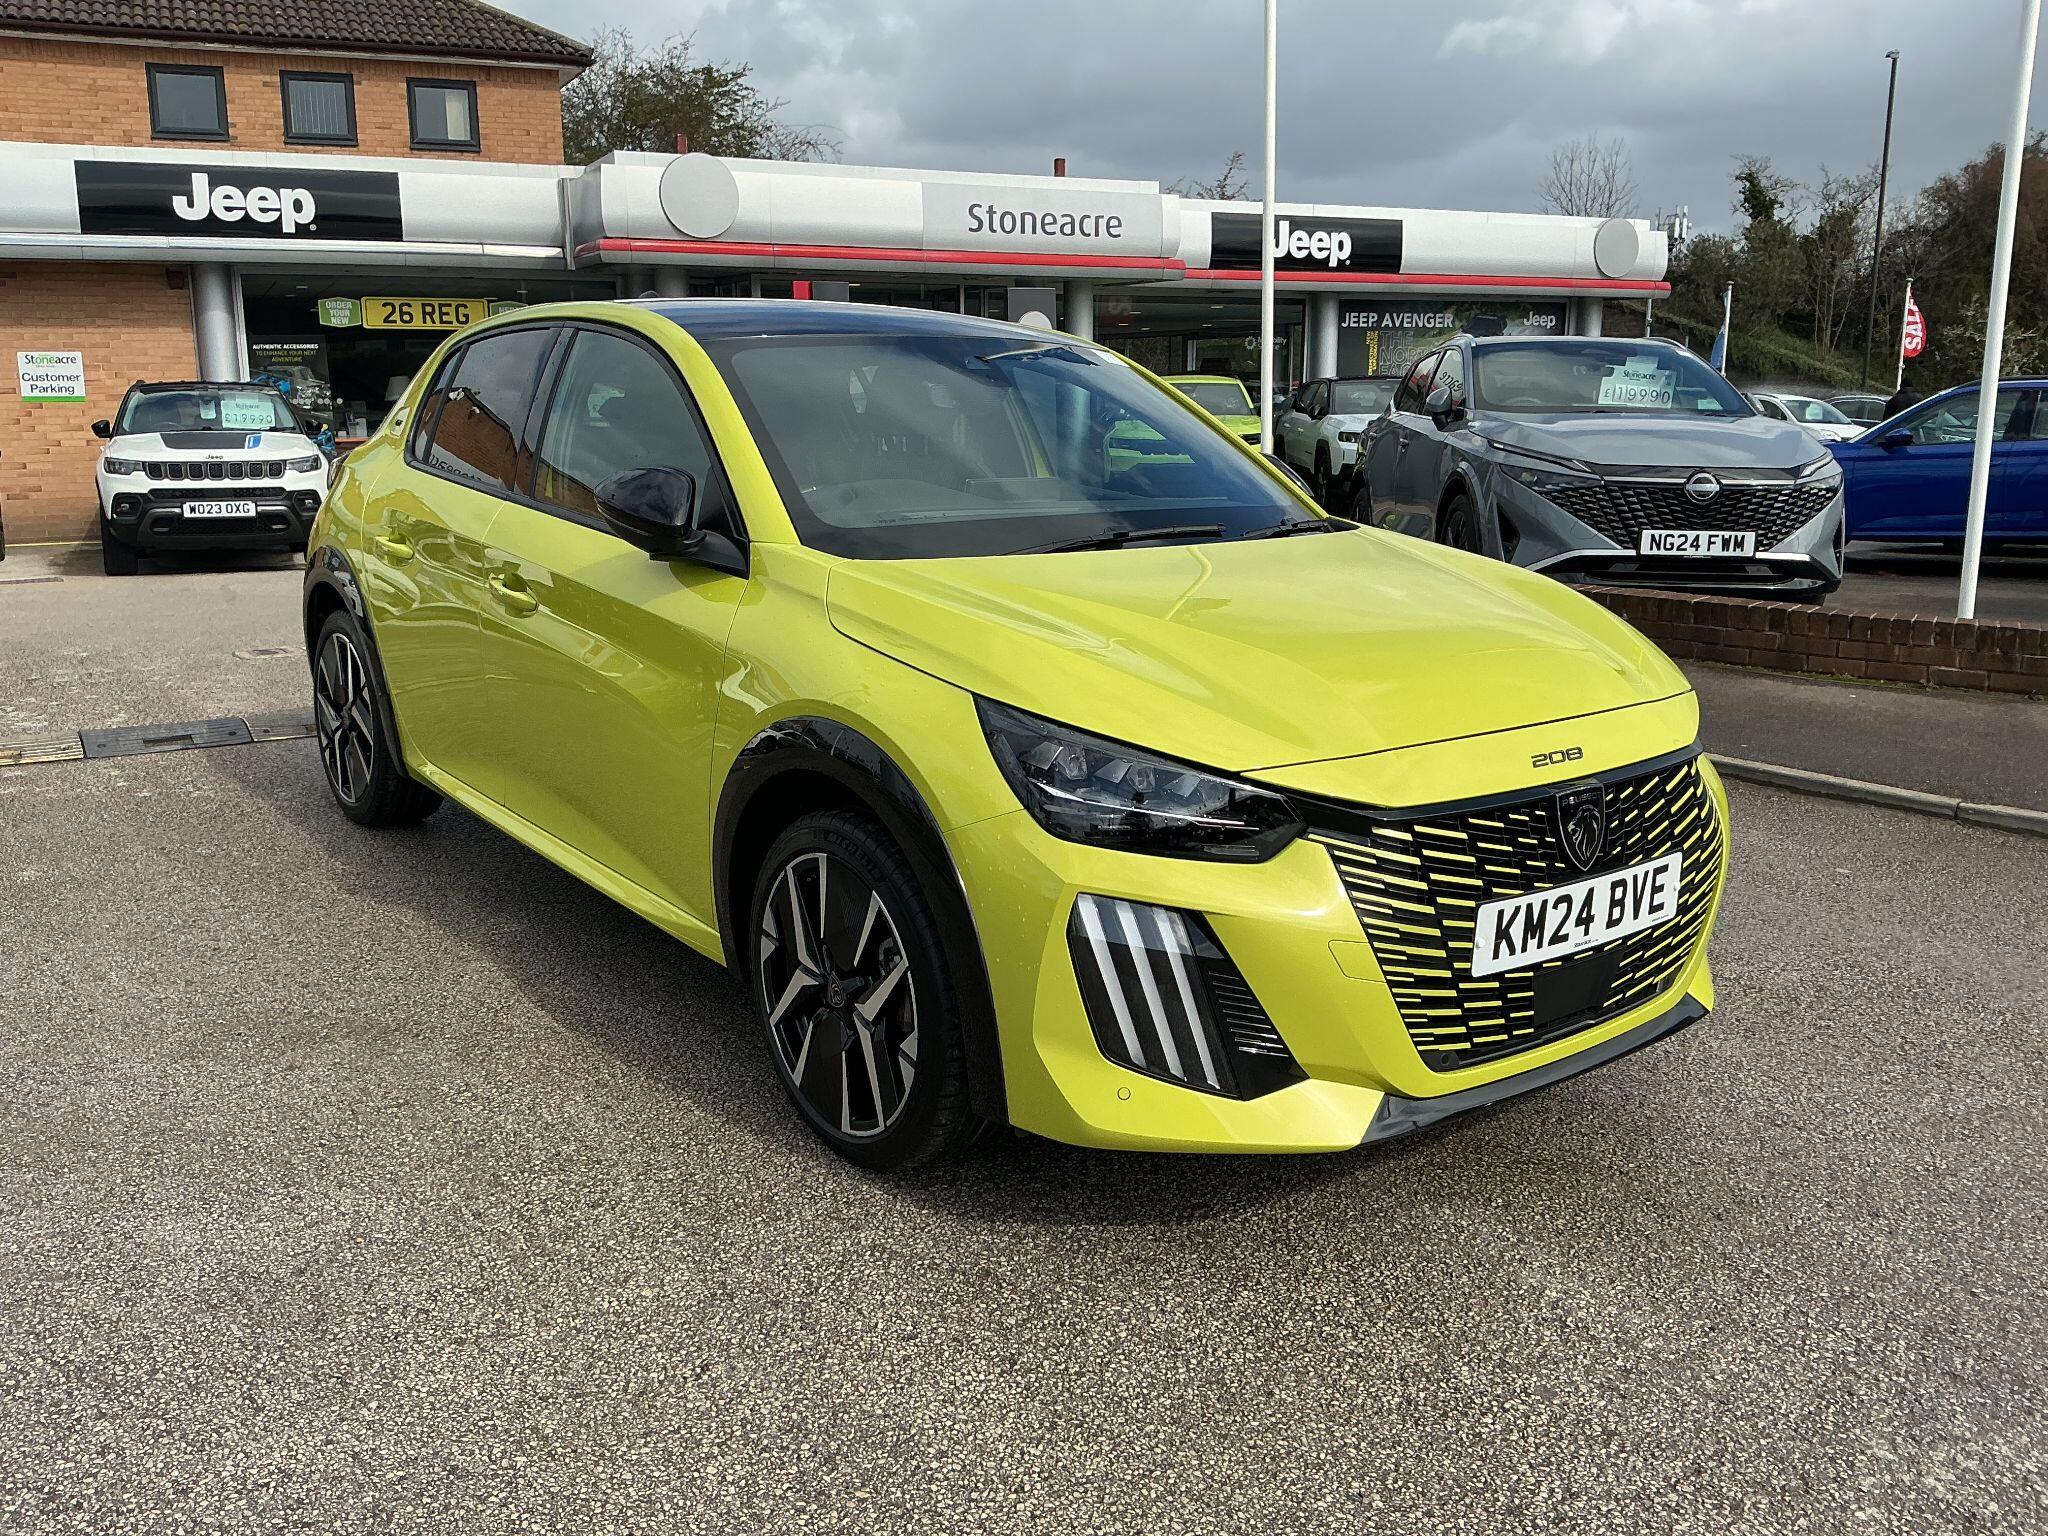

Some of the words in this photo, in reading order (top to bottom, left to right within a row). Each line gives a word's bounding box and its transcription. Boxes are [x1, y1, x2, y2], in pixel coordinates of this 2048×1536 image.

[172, 172, 317, 234] Jeep
[967, 203, 1123, 239] Stoneacre
[1273, 220, 1352, 268] Jeep
[325, 301, 353, 310] ORDER
[329, 309, 351, 317] YOUR
[381, 302, 414, 324] 26
[421, 303, 470, 325] REG
[331, 316, 350, 325] NEW
[1341, 312, 1378, 328] JEEP
[1381, 312, 1454, 328] AVENGER
[1523, 311, 1556, 329] Jeep
[1380, 331, 1414, 348] THE
[24, 354, 77, 365] Stoneacre
[22, 372, 81, 382] Customer
[1622, 369, 1656, 380] Stoneacre
[30, 383, 75, 395] Parking
[225, 503, 250, 514] OXG
[1649, 533, 1701, 552] NG24
[1706, 534, 1746, 552] FWM
[1531, 746, 1584, 769] 208
[1491, 886, 1596, 961] KM24
[1605, 862, 1670, 931] BVE
